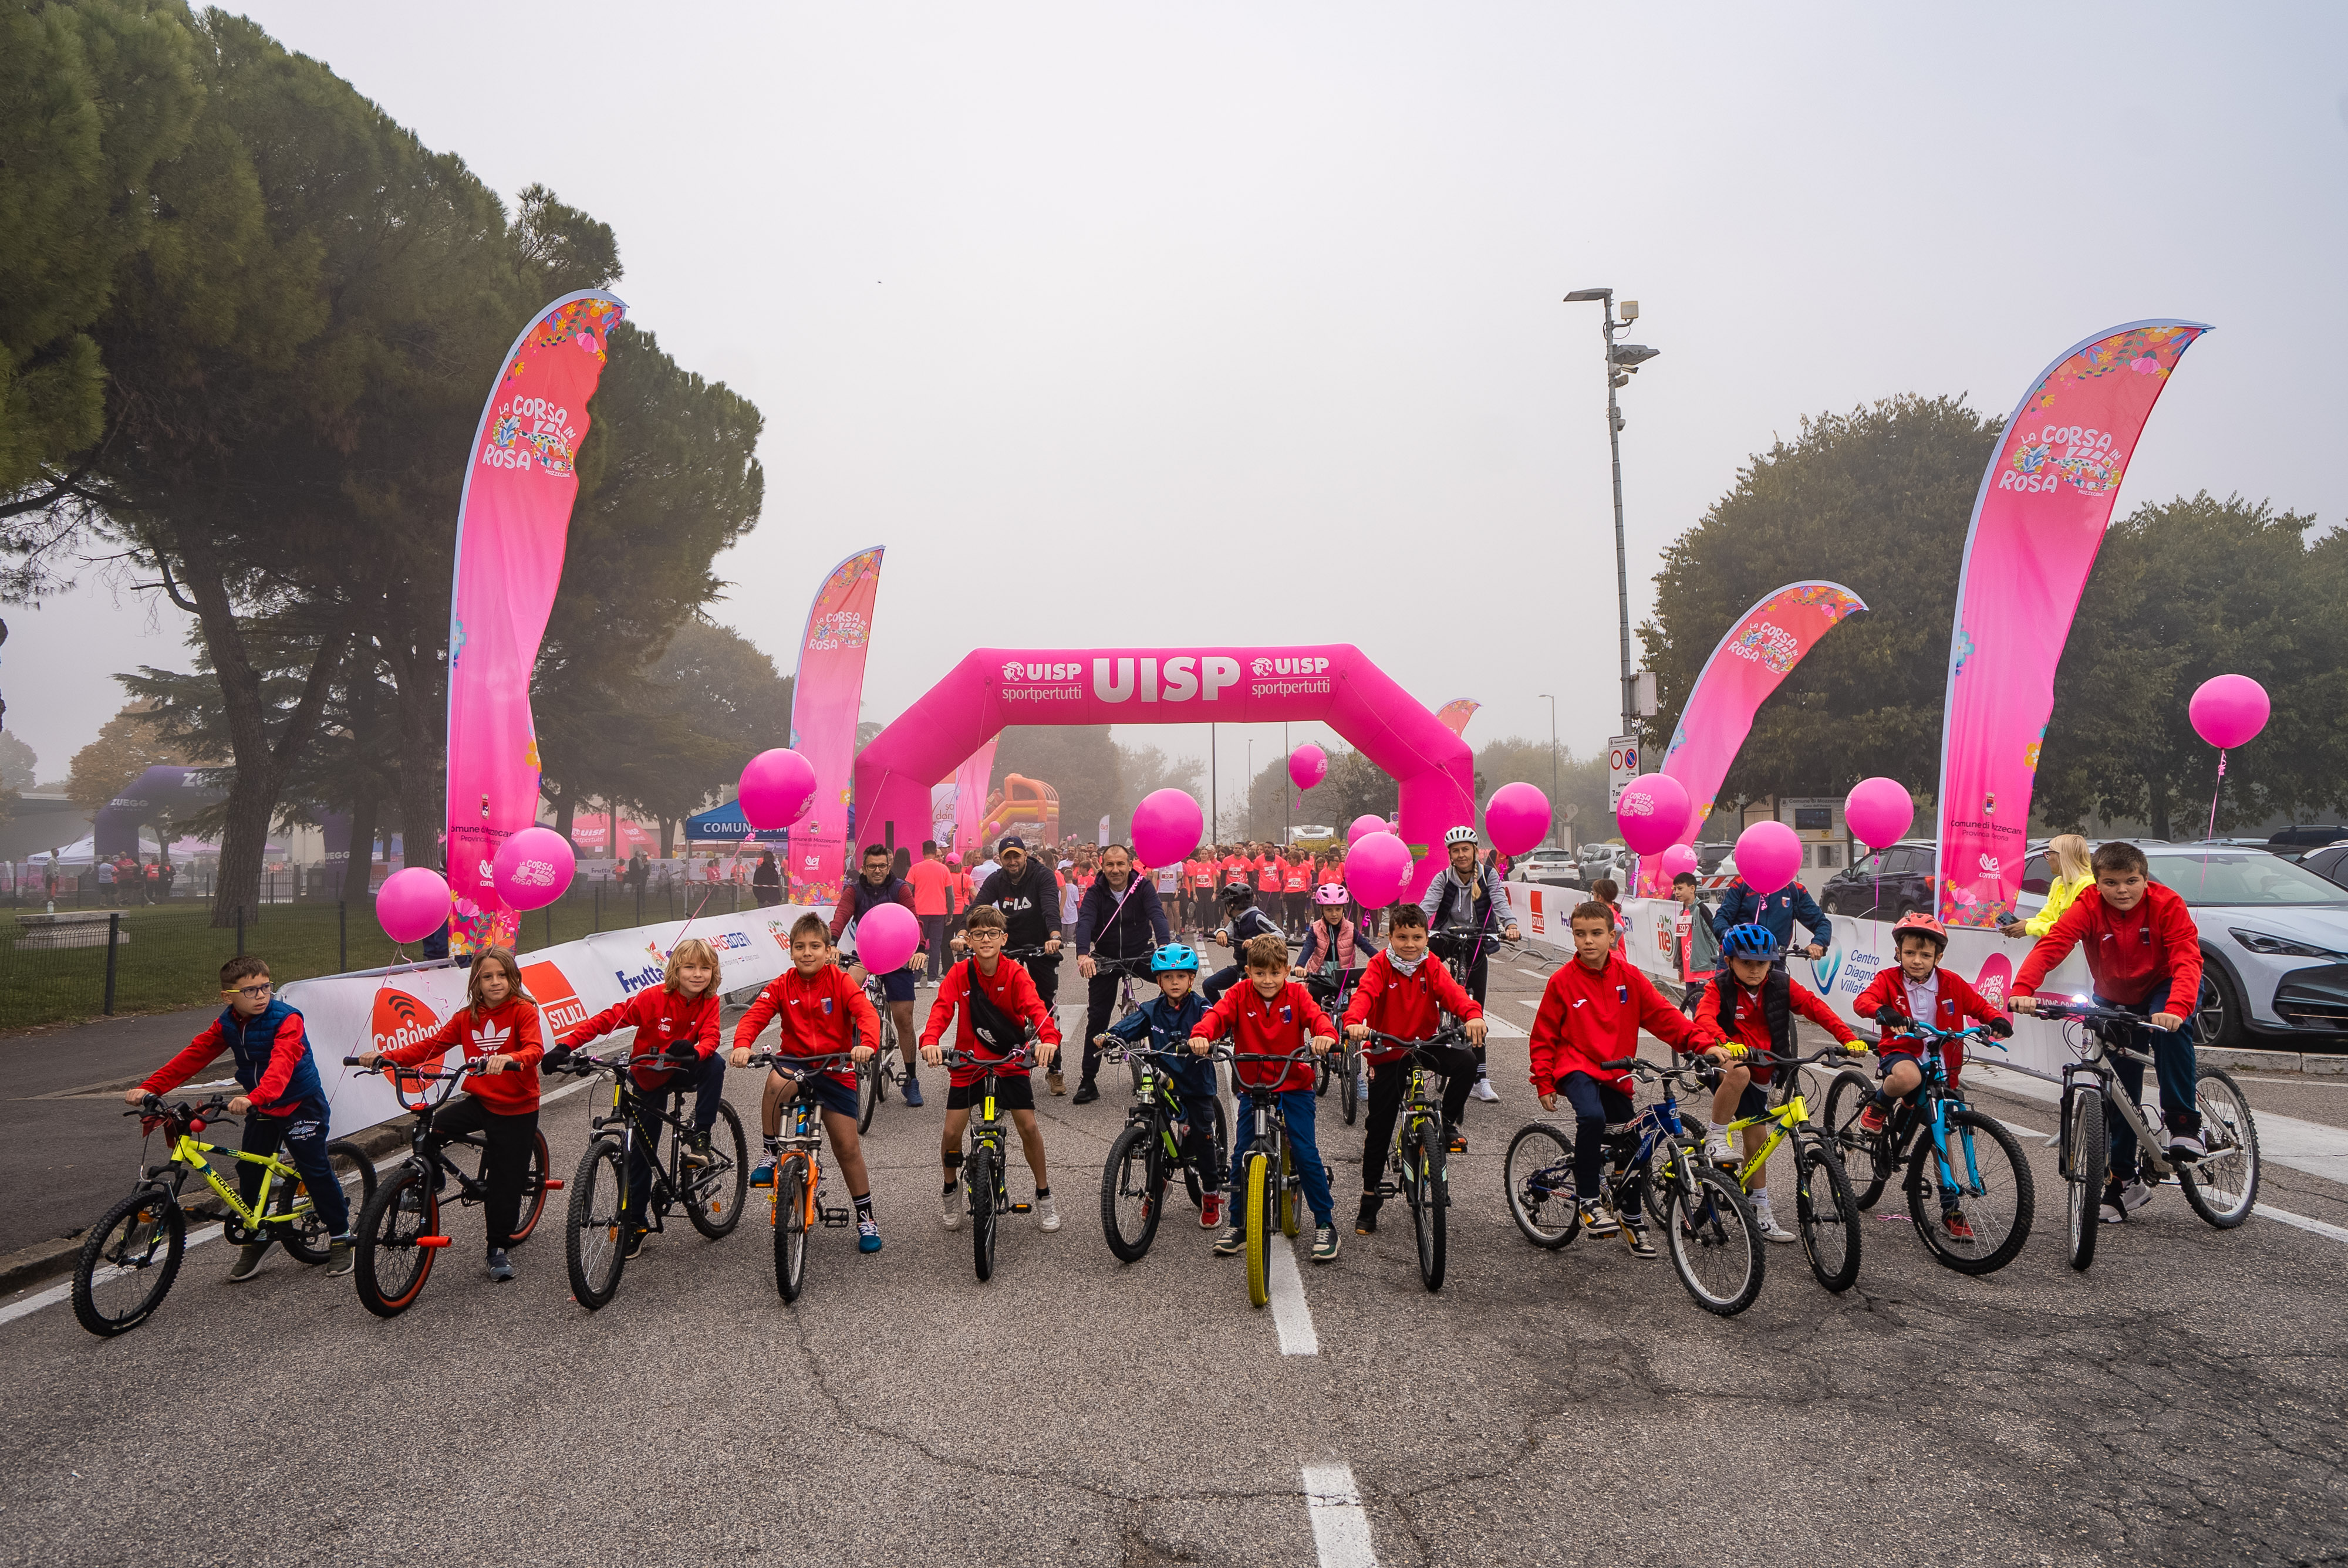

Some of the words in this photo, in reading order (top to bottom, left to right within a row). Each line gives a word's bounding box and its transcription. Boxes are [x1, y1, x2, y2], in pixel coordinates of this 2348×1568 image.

[498, 403, 510, 414] LA
[512, 394, 568, 428] CORSA
[563, 426, 576, 439] IN
[2020, 432, 2036, 444] LA
[2041, 424, 2112, 452] CORSA
[2109, 448, 2122, 460] IN
[482, 443, 531, 471] ROSA
[1998, 469, 2058, 493] ROSA
[826, 611, 861, 623] CORSA
[1760, 621, 1797, 650] CORSA
[808, 638, 838, 650] ROSA
[1728, 640, 1760, 662] ROSA
[1027, 663, 1082, 680] UISP
[1275, 657, 1330, 674] UISP
[1092, 657, 1240, 703] UISP
[1002, 685, 1082, 703] sportpertutti
[1251, 679, 1330, 698] sportpertutti
[110, 798, 149, 807] ZUEGG
[1629, 792, 1652, 802] CORSA
[936, 810, 954, 820] don
[1620, 808, 1634, 817] ROSA
[581, 828, 606, 836] UISP
[1951, 820, 1982, 828] Comune
[325, 851, 350, 860] UEGG
[527, 859, 554, 872] CORSA
[511, 874, 532, 886] ROSA
[1003, 897, 1032, 910] FILA
[1532, 917, 1545, 929] STULZ
[1679, 924, 1689, 932] 302
[1850, 949, 1880, 966] Centro
[615, 964, 666, 993] Frutta
[1984, 974, 2004, 989] CORSA
[548, 1002, 587, 1030] STULZ
[213, 1174, 255, 1219] ROCKRIDER
